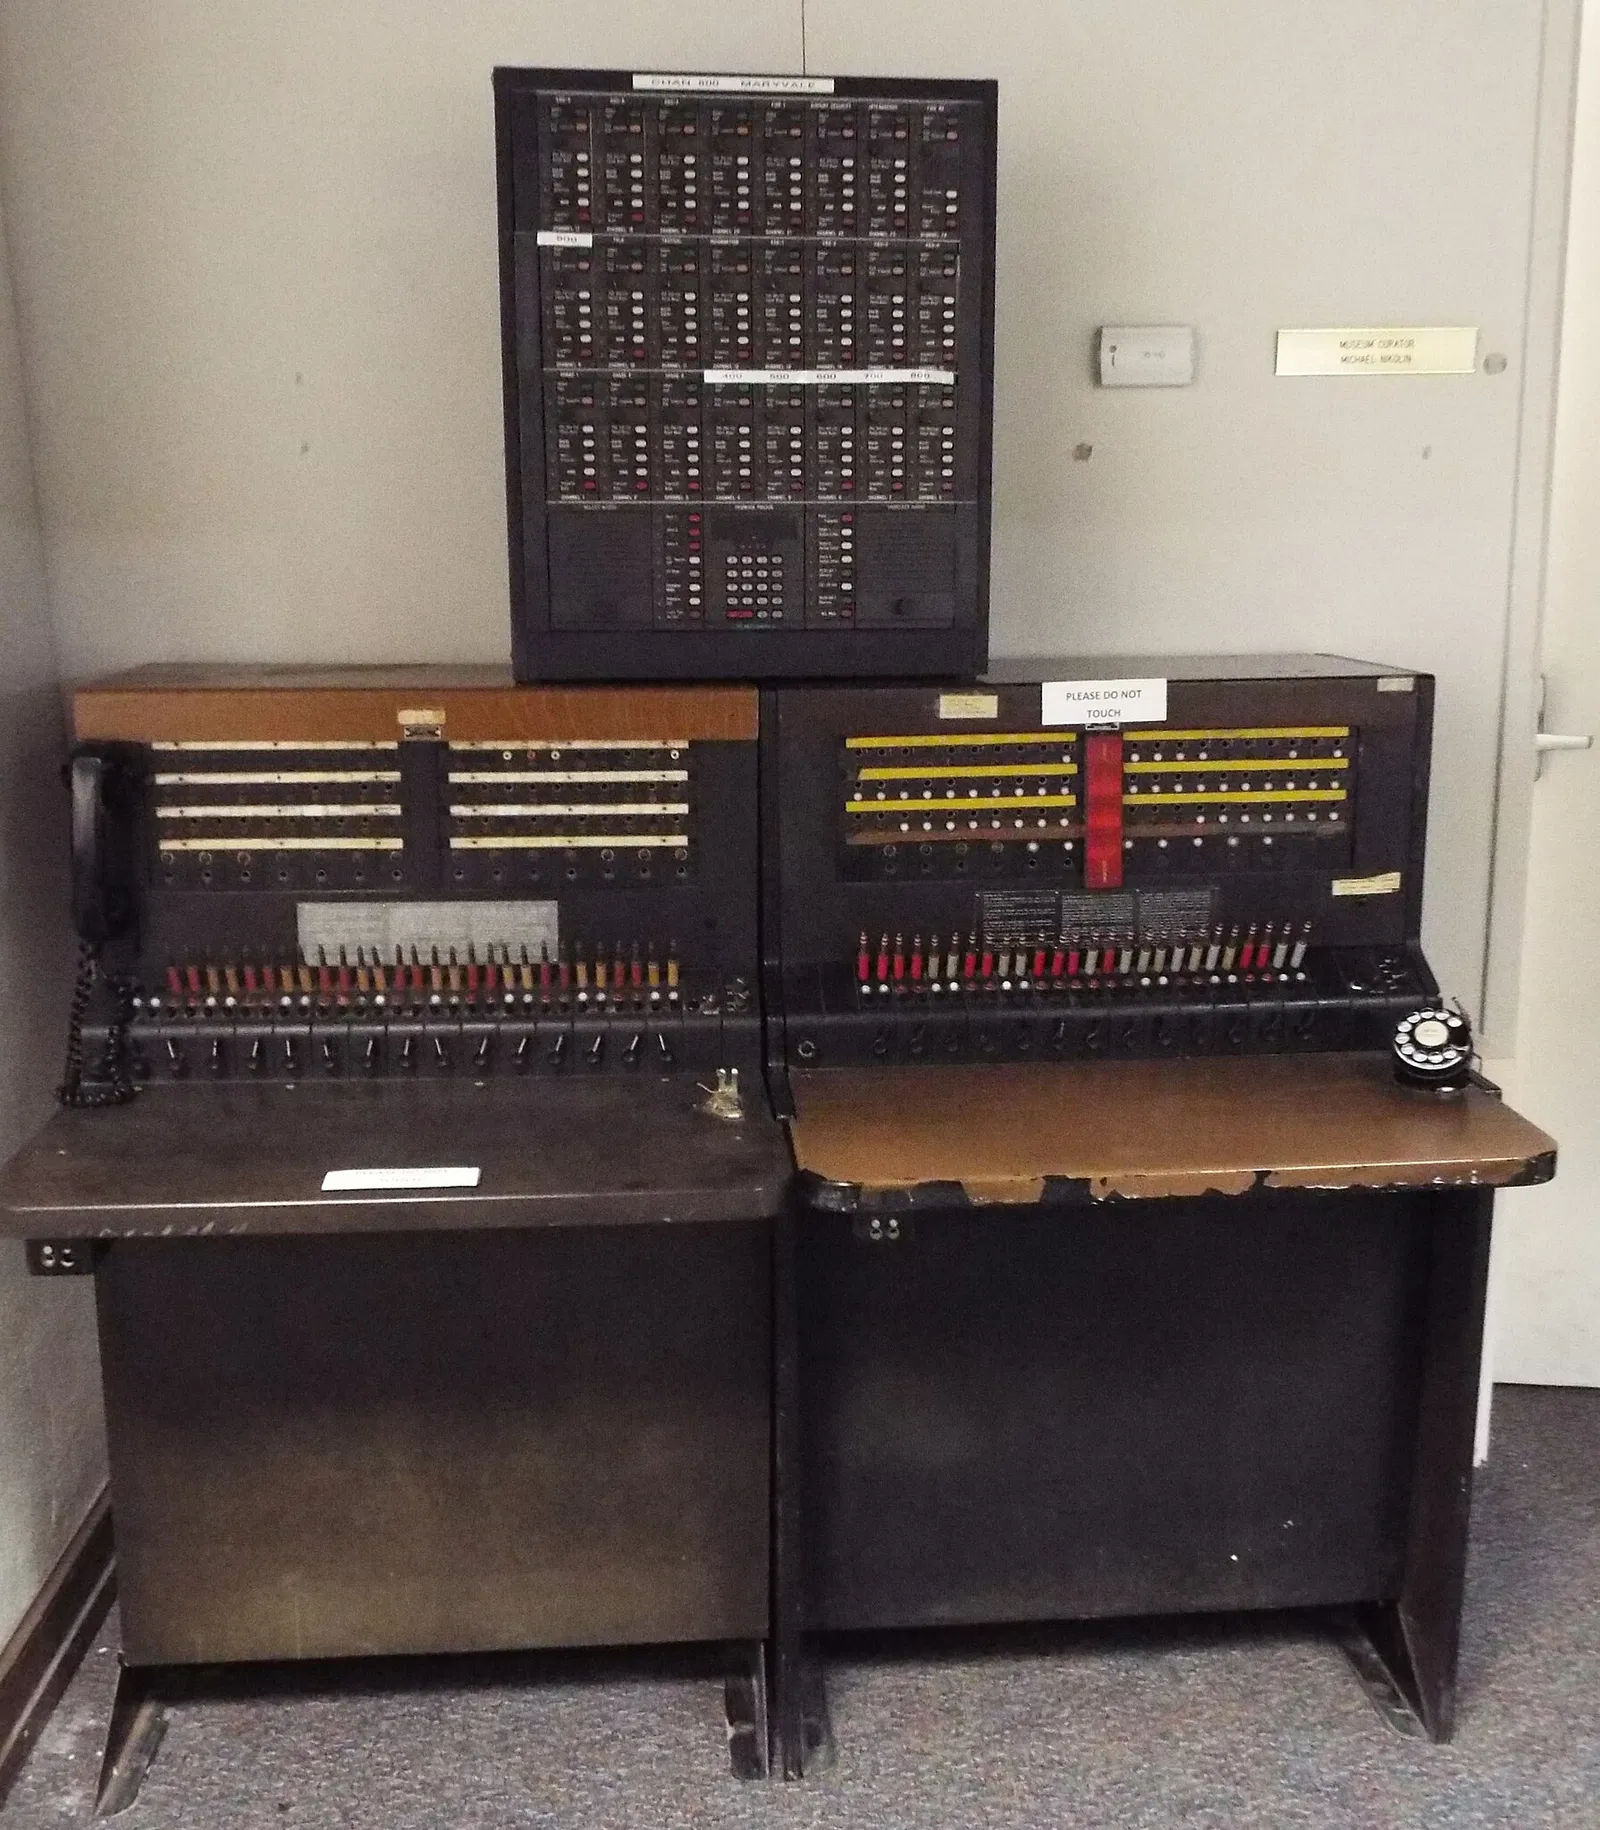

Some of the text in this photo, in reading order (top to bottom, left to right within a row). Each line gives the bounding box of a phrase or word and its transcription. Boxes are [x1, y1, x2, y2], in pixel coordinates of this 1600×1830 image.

[740, 80, 816, 89] MARYVALE
[1339, 338, 1415, 349] MUSEUM CURATOR
[1340, 354, 1376, 364] MICHAEL
[1066, 689, 1142, 701] PLEASE DO NOT
[1087, 709, 1121, 719] TOUCH
